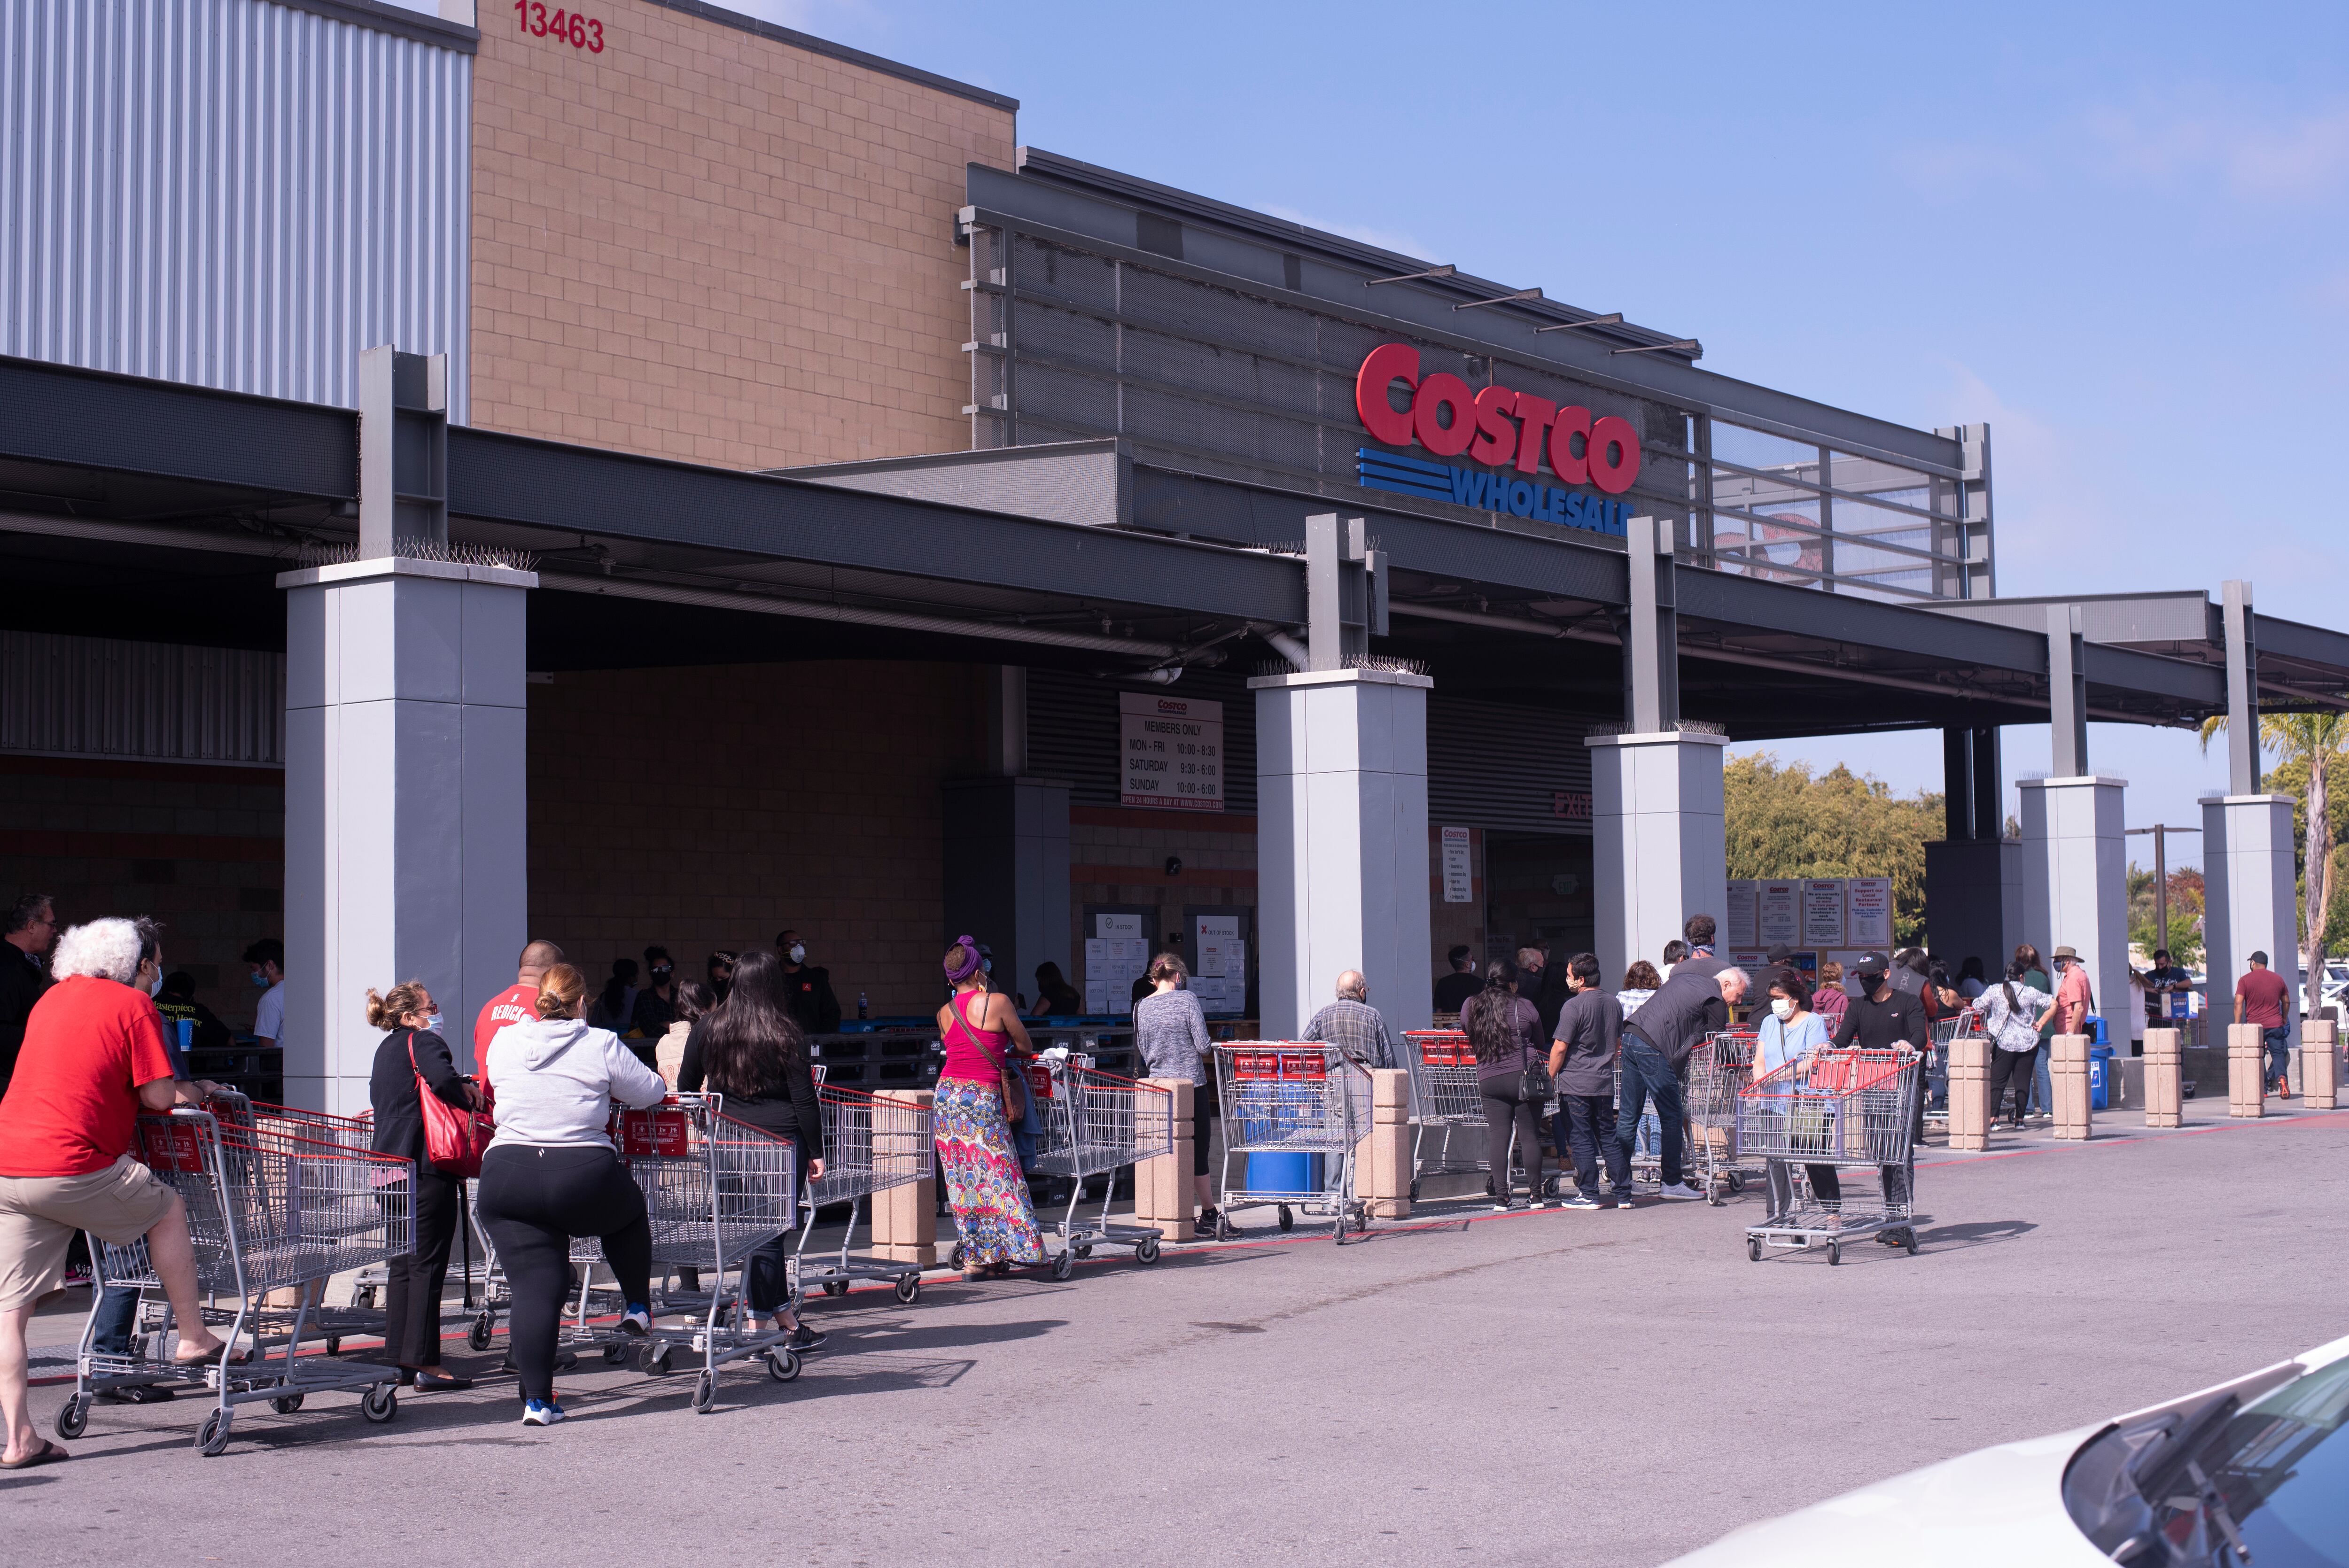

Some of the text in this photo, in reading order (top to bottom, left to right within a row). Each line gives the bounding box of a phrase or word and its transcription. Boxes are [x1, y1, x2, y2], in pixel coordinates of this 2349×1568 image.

[514, 0, 604, 53] 13463
[1356, 343, 1641, 494] COSTCO
[1158, 699, 1187, 711] COSTCO
[1145, 721, 1201, 736] MEMBERS ONLY
[1130, 739, 1147, 751] MON
[1154, 741, 1165, 752] FRI
[1177, 743, 1195, 755] 10:00
[1202, 745, 1215, 757] 8:30
[1130, 758, 1168, 772] SATURDAY
[1181, 763, 1195, 774] 9:30
[1202, 765, 1215, 776] 6:00
[1130, 778, 1159, 791] SUNDAY
[1177, 782, 1195, 793] 10:00
[1202, 784, 1215, 795] 6:00
[1180, 800, 1222, 808] WWW.COSTCO.COM
[1555, 793, 1592, 819] EXIT
[1444, 830, 1467, 838] COSTCO
[1559, 881, 1571, 892] EXIT
[491, 1004, 526, 1022] REDICK
